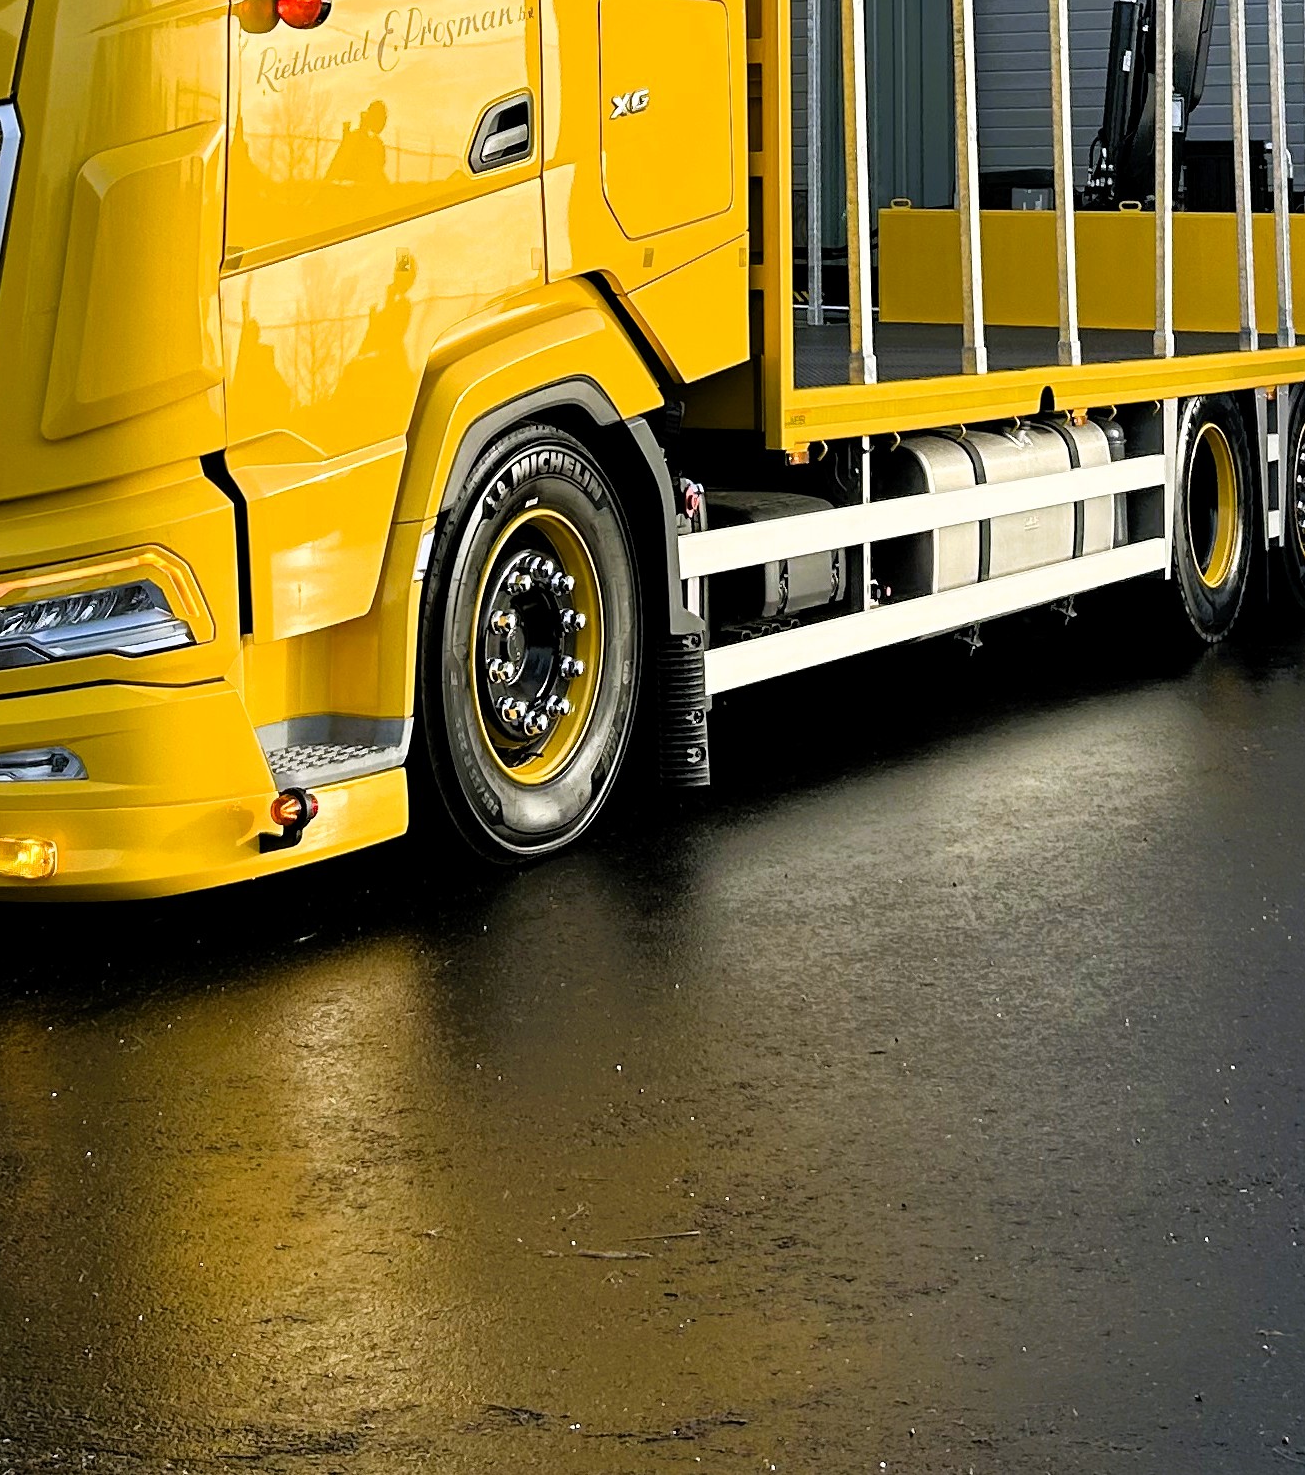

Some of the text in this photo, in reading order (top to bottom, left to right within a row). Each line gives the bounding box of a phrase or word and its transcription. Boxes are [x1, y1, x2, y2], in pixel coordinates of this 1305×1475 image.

[256, 30, 370, 92] Riethandel
[609, 88, 650, 120] XG
[511, 450, 604, 503] MICHELIN
